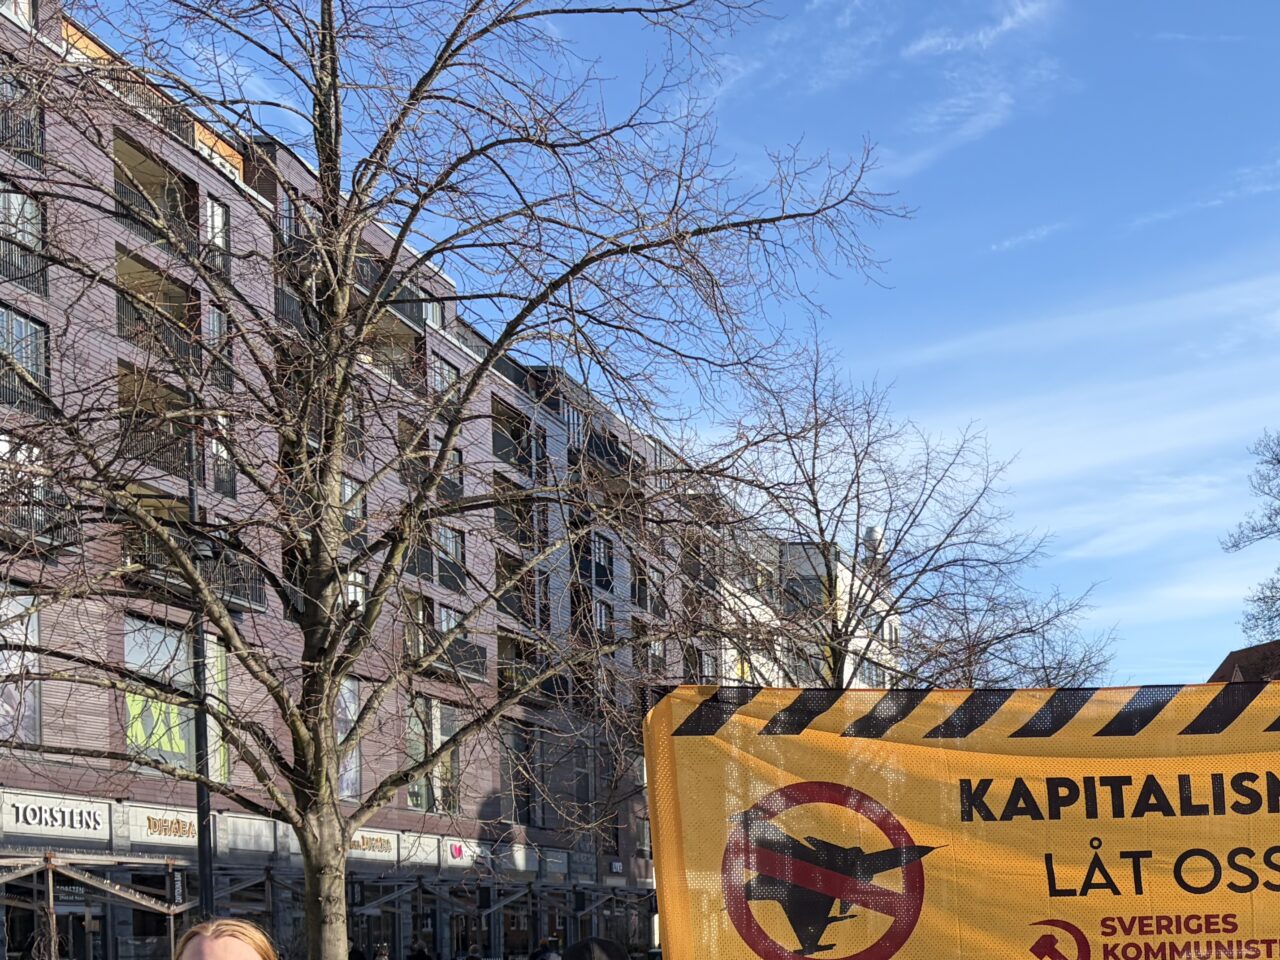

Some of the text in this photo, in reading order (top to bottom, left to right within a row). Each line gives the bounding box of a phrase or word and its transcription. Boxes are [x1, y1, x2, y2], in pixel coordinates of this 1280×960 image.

[12, 802, 104, 831] TORSTENS
[147, 815, 197, 839] DHABA
[1044, 837, 1153, 898] LÅT
[1100, 913, 1239, 937] SVERIGES
